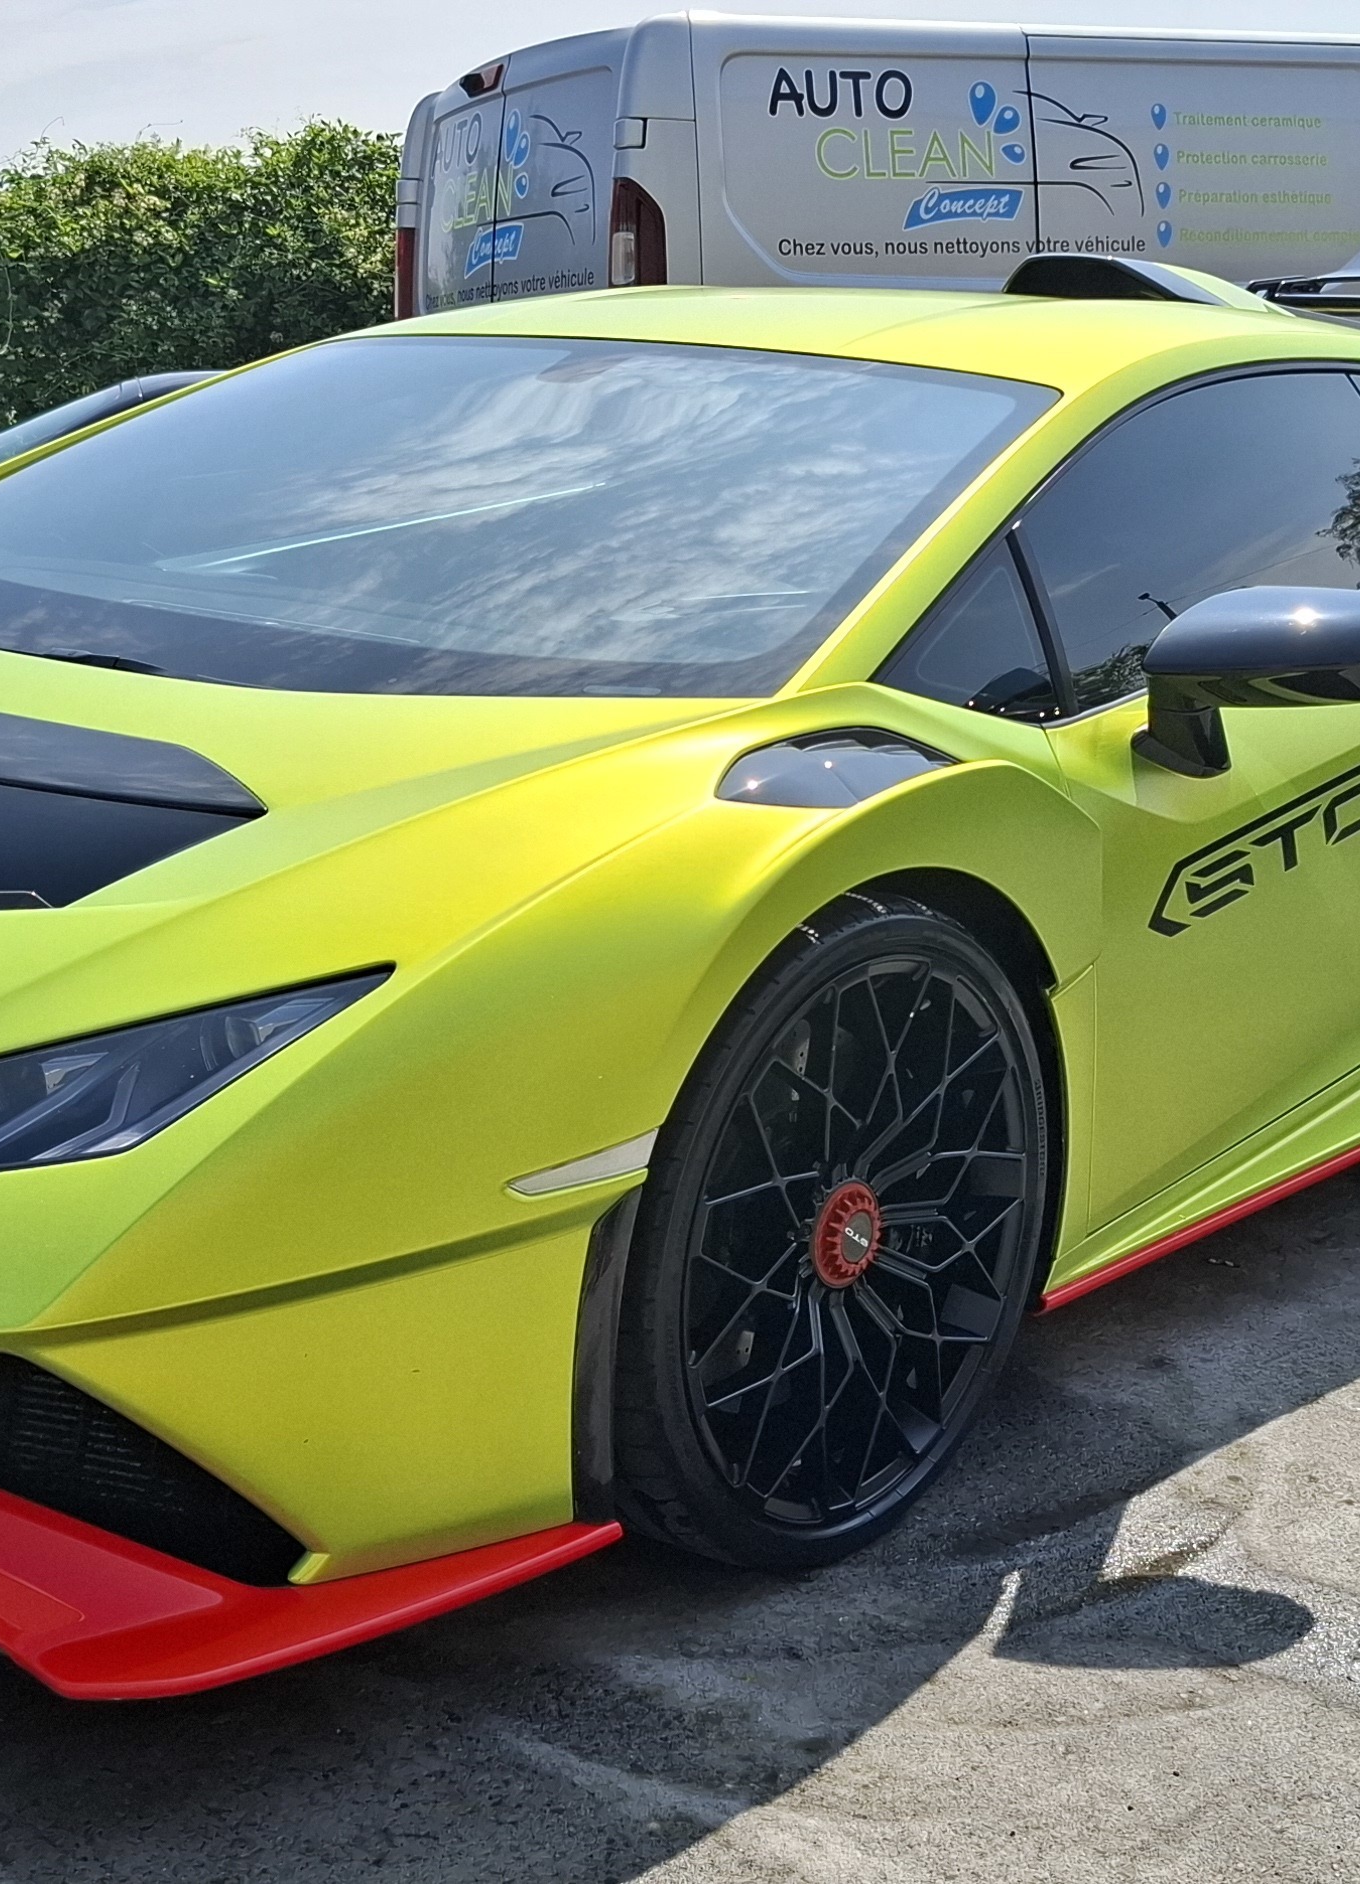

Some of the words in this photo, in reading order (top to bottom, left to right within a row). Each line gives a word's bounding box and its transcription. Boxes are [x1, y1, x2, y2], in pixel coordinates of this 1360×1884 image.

[768, 67, 913, 118] AUTO
[1173, 112, 1248, 127] Traitement
[815, 127, 994, 179] CLEAN
[1177, 151, 1247, 165] Protection
[1251, 153, 1328, 167] carrosserie
[440, 162, 514, 233] CLEAN
[919, 188, 1009, 220] Concept
[778, 238, 826, 256] Chez
[831, 240, 879, 258] vous,
[885, 240, 928, 255] nous
[934, 237, 1021, 258] nettoyons
[1026, 237, 1070, 253] votre
[1075, 235, 1146, 253] véhicule
[457, 287, 474, 302] nous
[521, 274, 546, 293] votre
[548, 267, 594, 289] véhicule
[844, 1227, 869, 1248] STO
